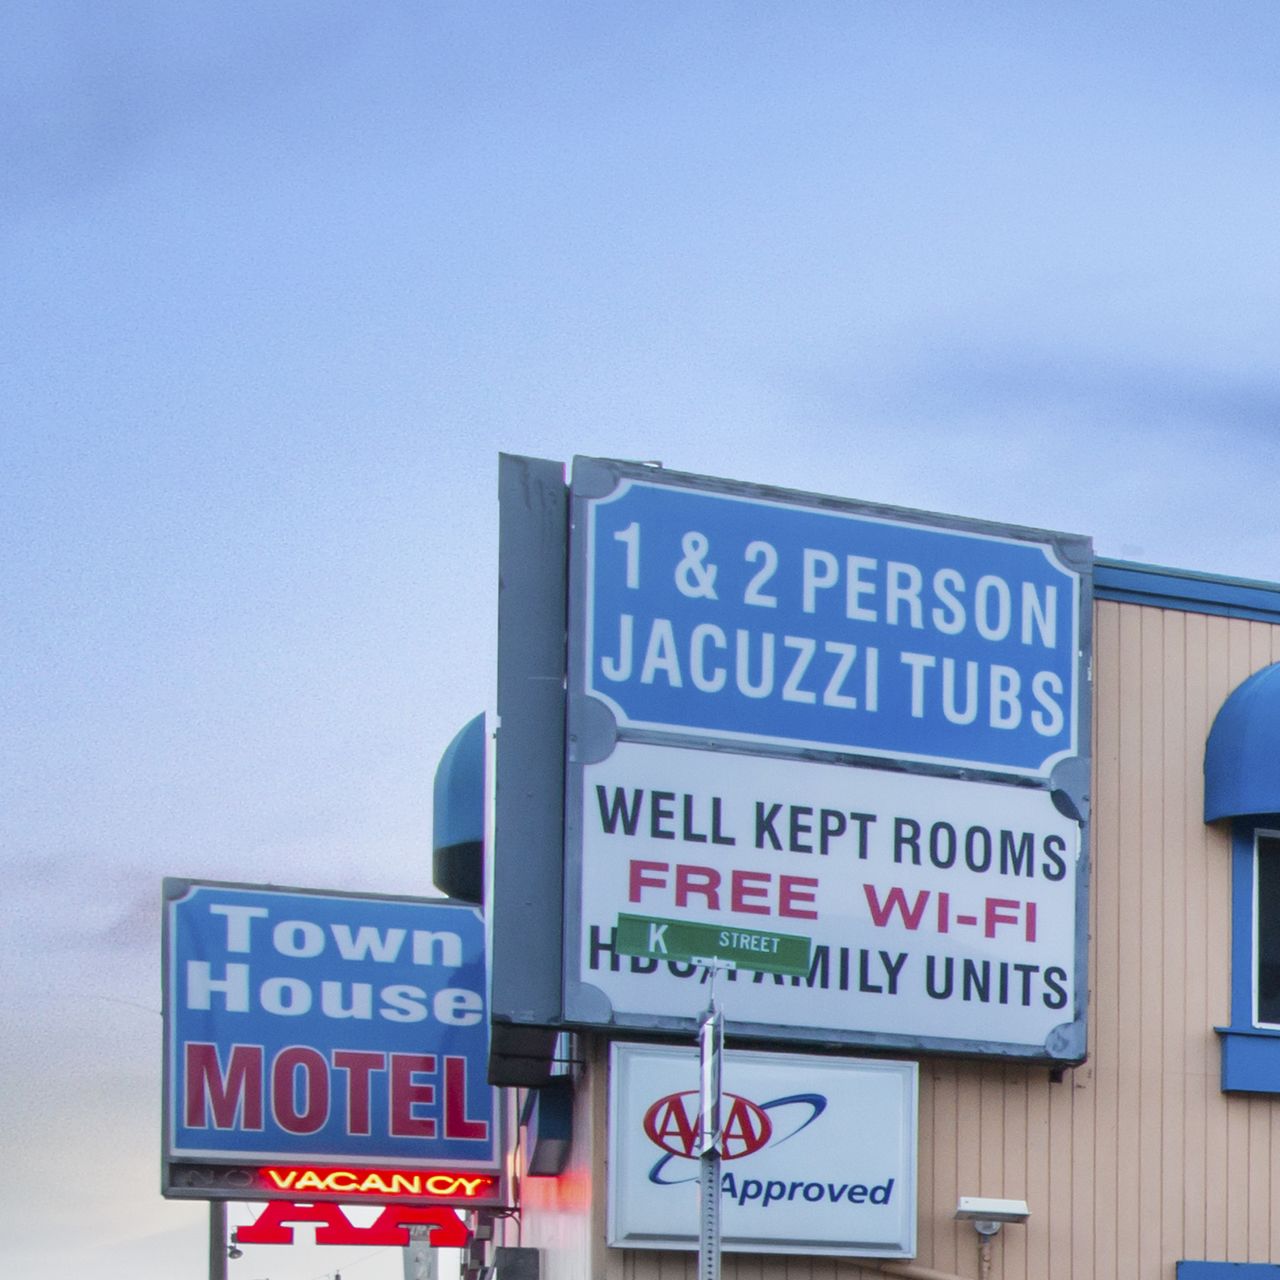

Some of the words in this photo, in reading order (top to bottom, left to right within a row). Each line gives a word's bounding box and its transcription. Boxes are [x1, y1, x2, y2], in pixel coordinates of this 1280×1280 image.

[613, 522, 642, 590] 1
[674, 531, 719, 600] &
[743, 541, 779, 608] 2
[803, 548, 1058, 649] PERSON
[601, 614, 879, 712] JACUZZI
[901, 652, 1065, 737] TUBS
[595, 785, 736, 846] WELL
[755, 801, 877, 859] KEPT
[894, 817, 1067, 882] ROOMS
[628, 859, 819, 921] FREE
[863, 883, 1037, 943] WI-FI
[210, 904, 462, 968] Town
[650, 923, 668, 954] K
[719, 931, 780, 954] STREET
[187, 960, 483, 1026] House
[925, 958, 1068, 1010] UNITS
[184, 1040, 489, 1142] MOTEL
[656, 1096, 760, 1156] AA
[268, 1170, 482, 1196] VACANCY
[721, 1172, 895, 1207] Approved
